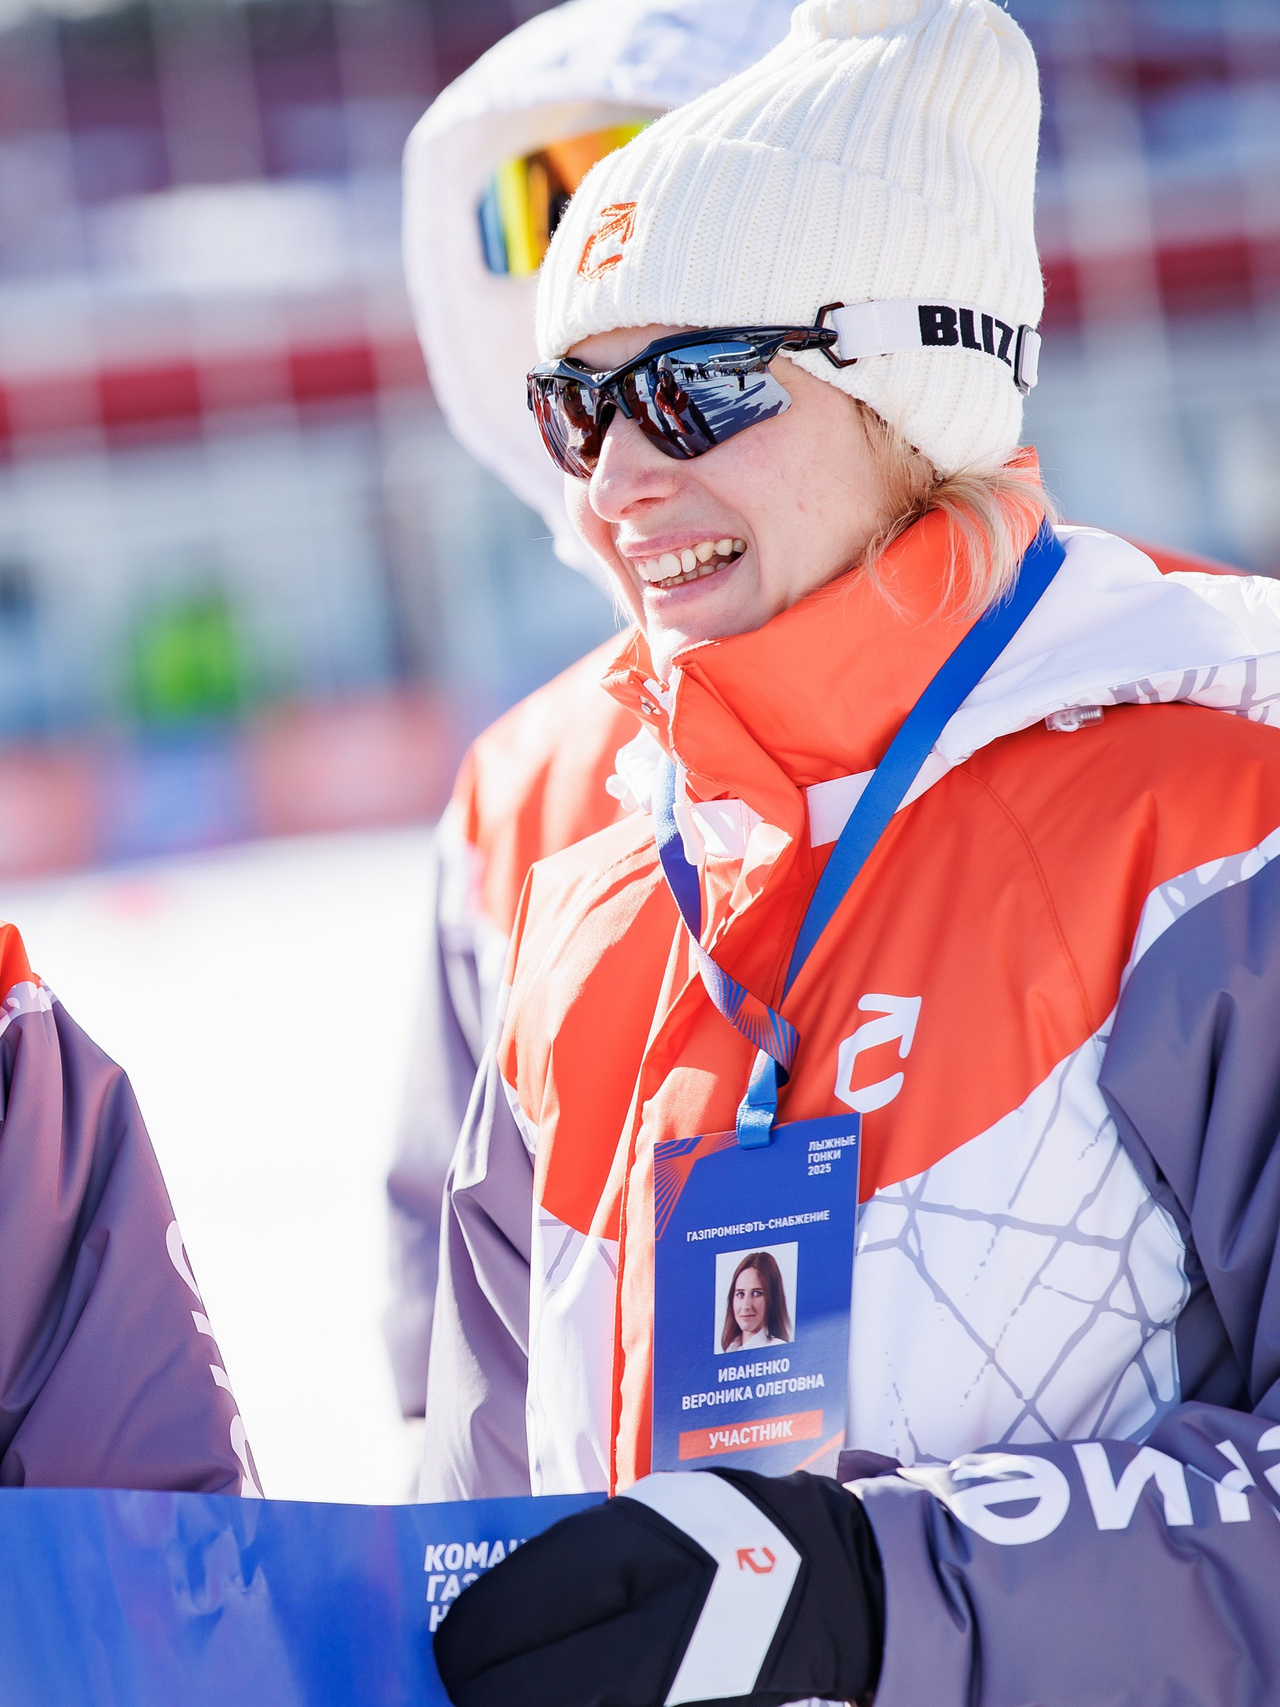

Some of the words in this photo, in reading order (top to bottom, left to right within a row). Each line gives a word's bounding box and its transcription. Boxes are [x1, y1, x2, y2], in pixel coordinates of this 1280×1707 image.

[918, 305, 1014, 368] BLIZ
[807, 1149, 841, 1163] ГОНКИ
[808, 1135, 856, 1151] ЛЫЖНЫЕ
[807, 1163, 831, 1176] 2025
[686, 1210, 830, 1242] ГАЗПРОМНЕФТЬ-СНАБЖЕНИЕ
[718, 1358, 790, 1383] ИВАНЕНКО
[682, 1386, 753, 1410] ВЕРОНИКА
[755, 1373, 825, 1398] ОЛЕГОВНА
[709, 1420, 793, 1449] УЧАСТНИК
